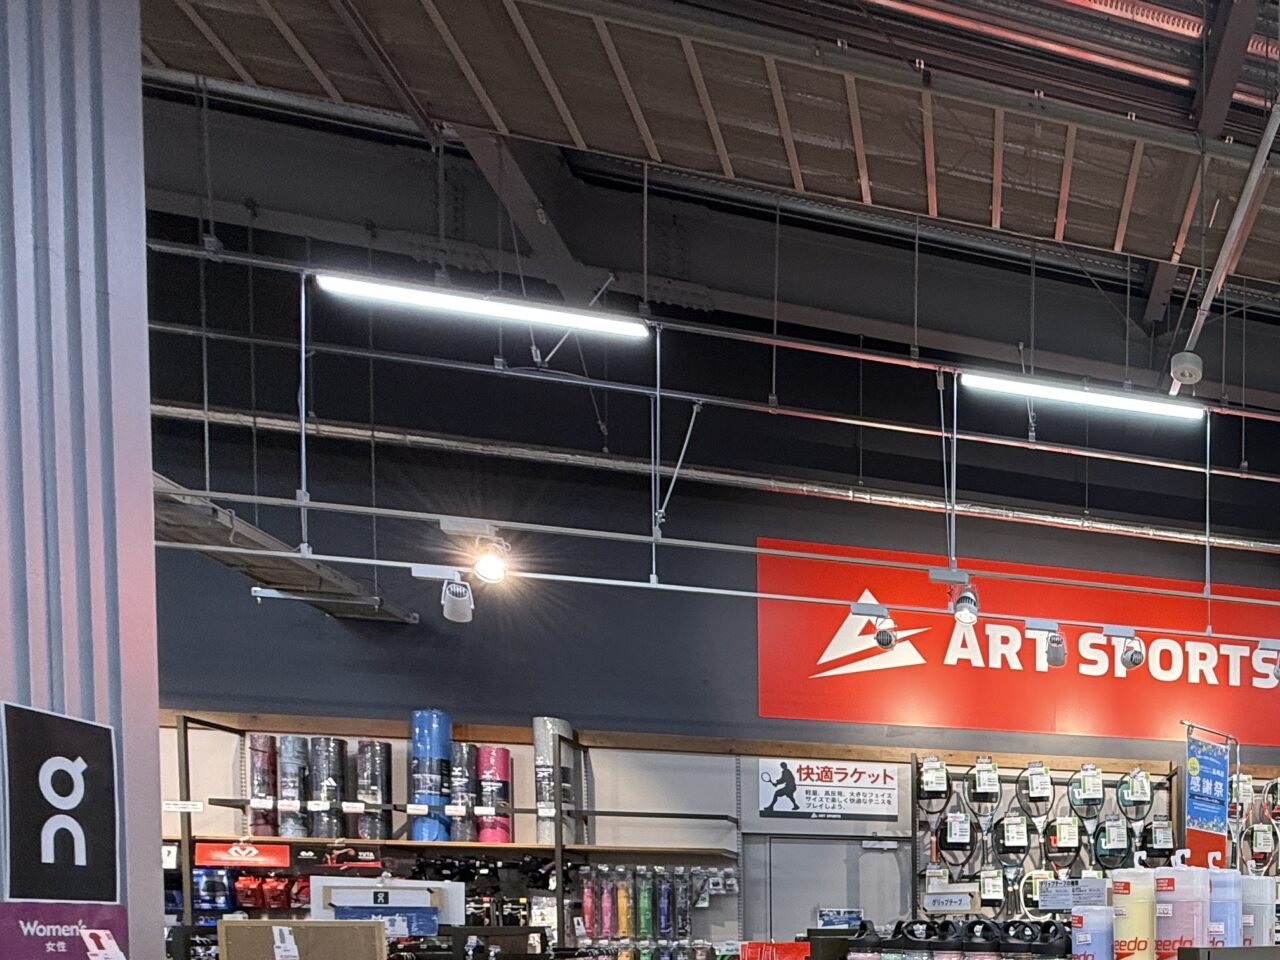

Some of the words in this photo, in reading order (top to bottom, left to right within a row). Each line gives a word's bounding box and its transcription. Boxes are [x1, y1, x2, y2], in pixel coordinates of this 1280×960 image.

[943, 621, 1056, 672] ART
[1078, 631, 1280, 690] SPORTS
[796, 764, 895, 785] 快適ラケット
[1190, 775, 1224, 798] 感謝祭
[932, 899, 963, 907] グリップテープ
[45, 941, 68, 953] 女性
[1114, 936, 1149, 951] eedo
